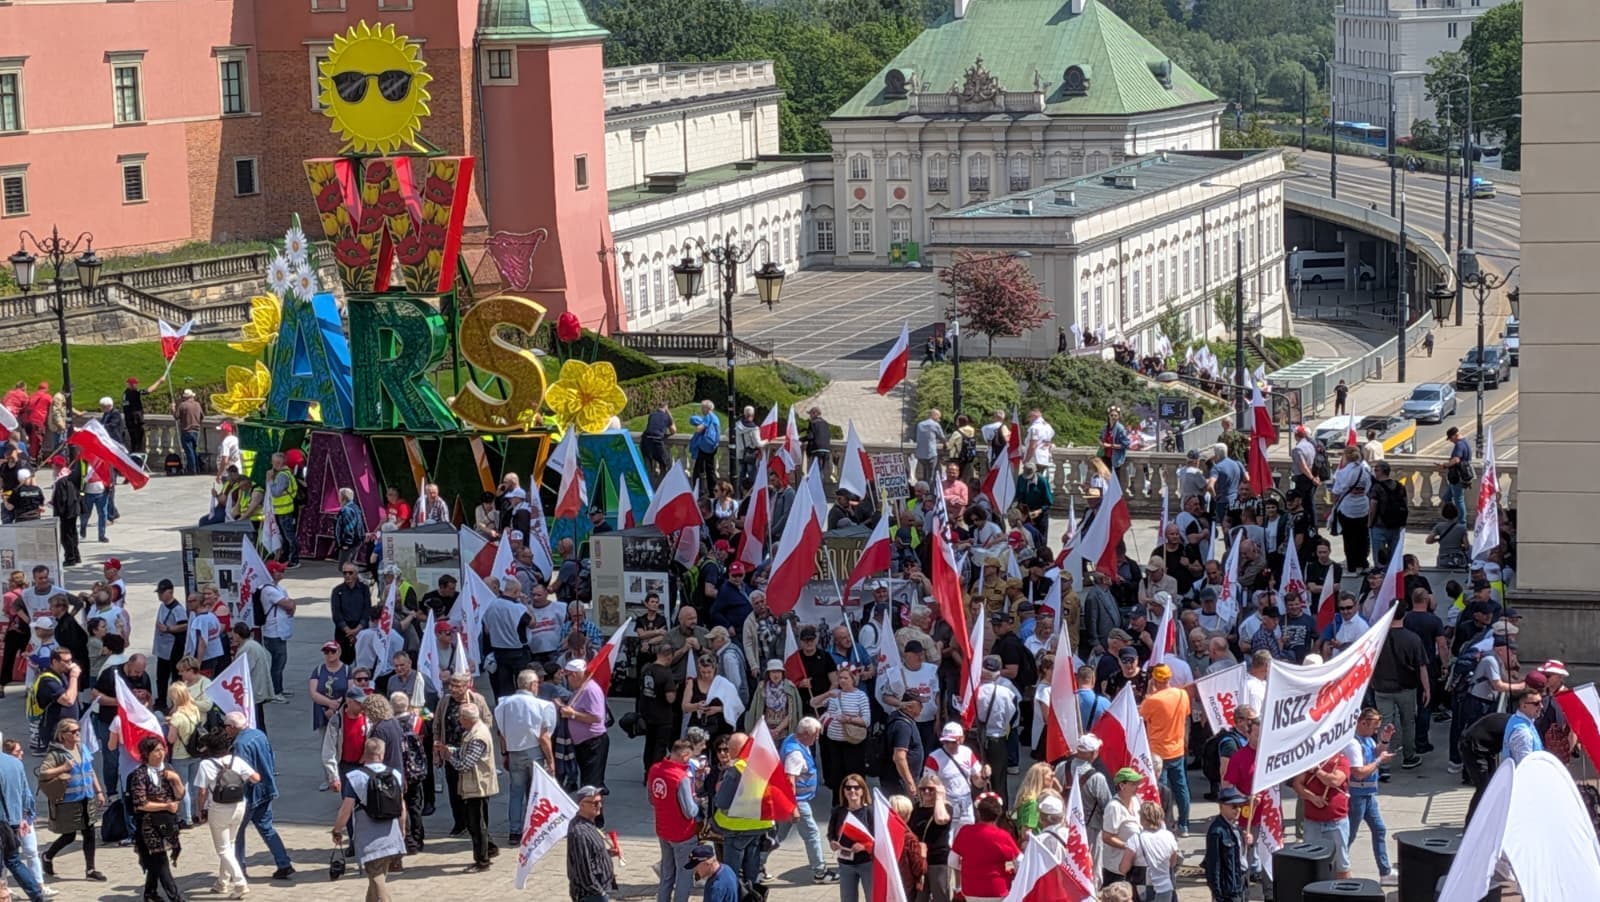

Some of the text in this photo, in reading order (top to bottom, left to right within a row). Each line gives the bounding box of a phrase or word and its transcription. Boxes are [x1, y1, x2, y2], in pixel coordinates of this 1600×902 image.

[303, 155, 475, 293] W
[267, 292, 547, 433] ARS
[1265, 736, 1316, 774] REGION
[1272, 692, 1312, 731] NSZZ
